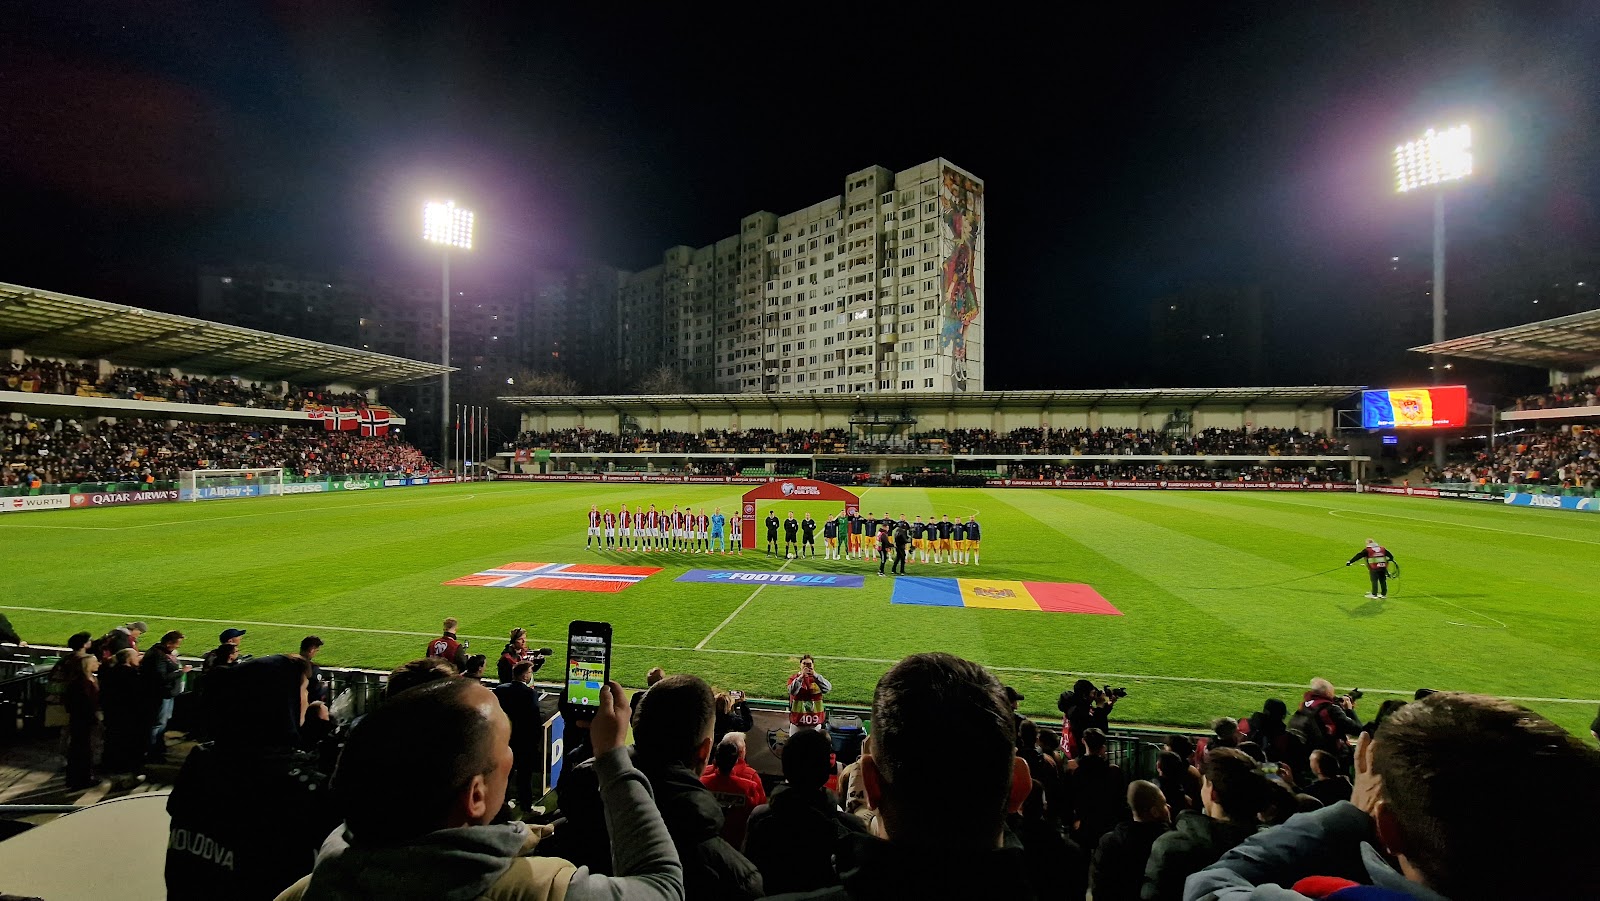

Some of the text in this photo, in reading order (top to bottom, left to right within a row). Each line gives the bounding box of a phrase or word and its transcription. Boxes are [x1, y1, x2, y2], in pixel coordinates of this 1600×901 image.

[269, 483, 322, 494] Hsense
[344, 480, 370, 490] Carlsberg
[92, 490, 178, 504] QATAR AIRWAYS
[706, 572, 837, 584] #FOOTBALL
[800, 715, 819, 724] 409
